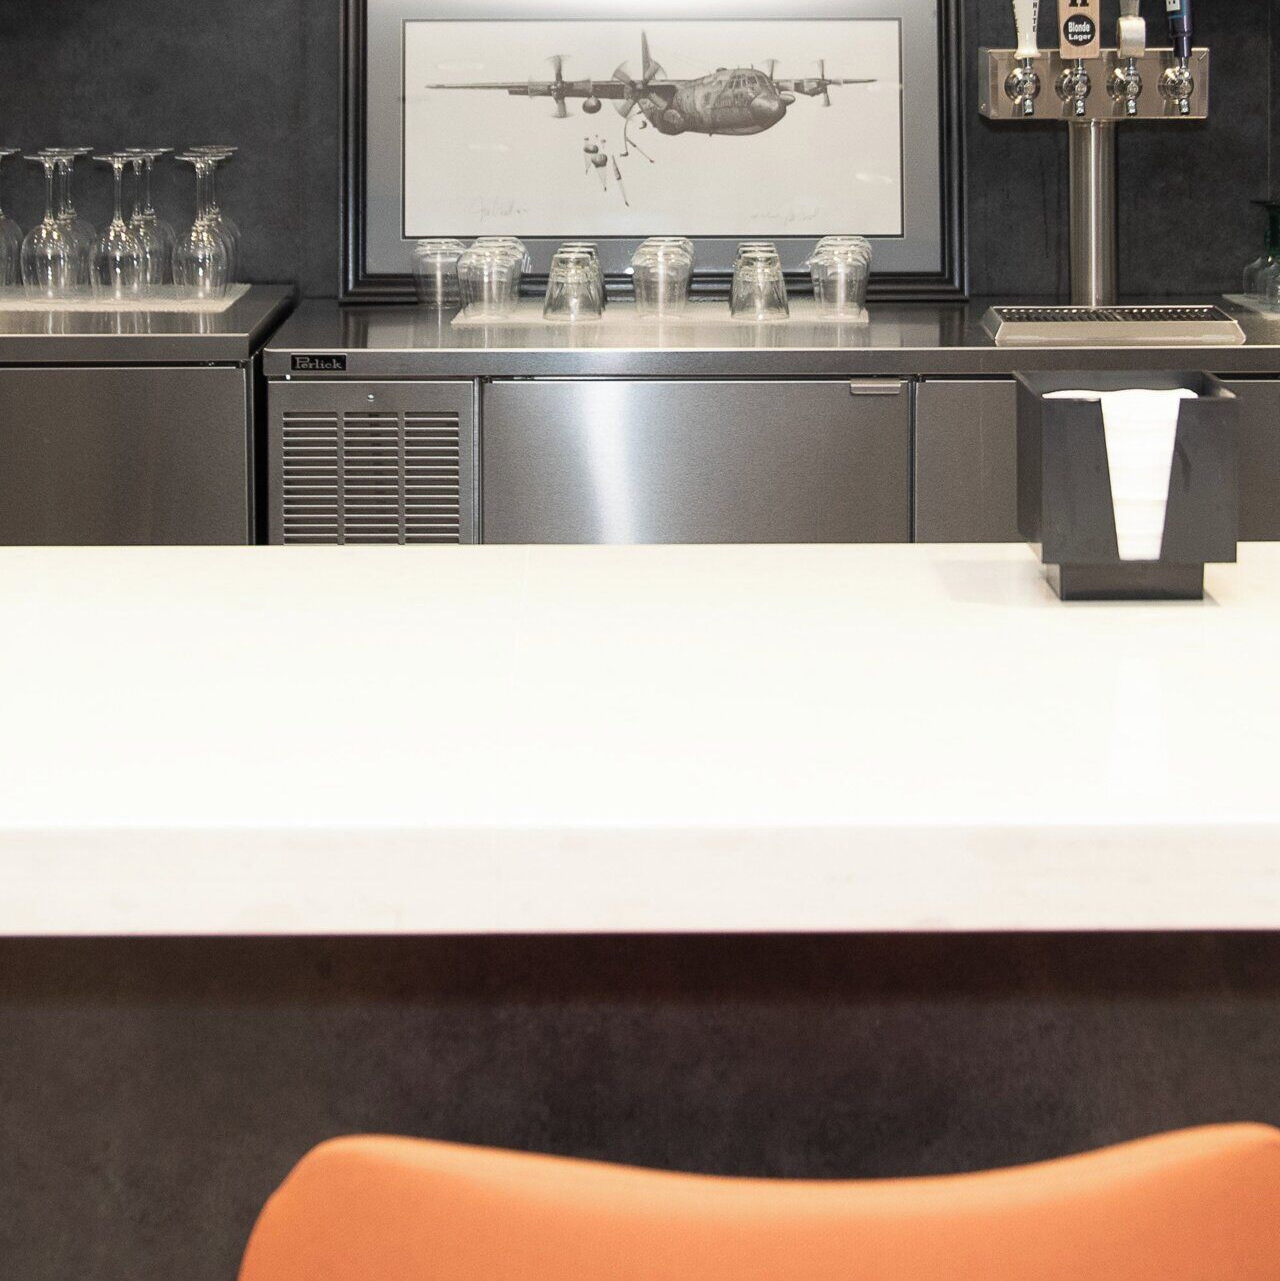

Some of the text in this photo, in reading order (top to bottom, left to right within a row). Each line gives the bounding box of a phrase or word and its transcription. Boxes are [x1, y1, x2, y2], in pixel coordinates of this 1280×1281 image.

[1068, 21, 1091, 33] Blonde
[1068, 33, 1092, 42] Lager
[295, 356, 343, 369] Perlick
